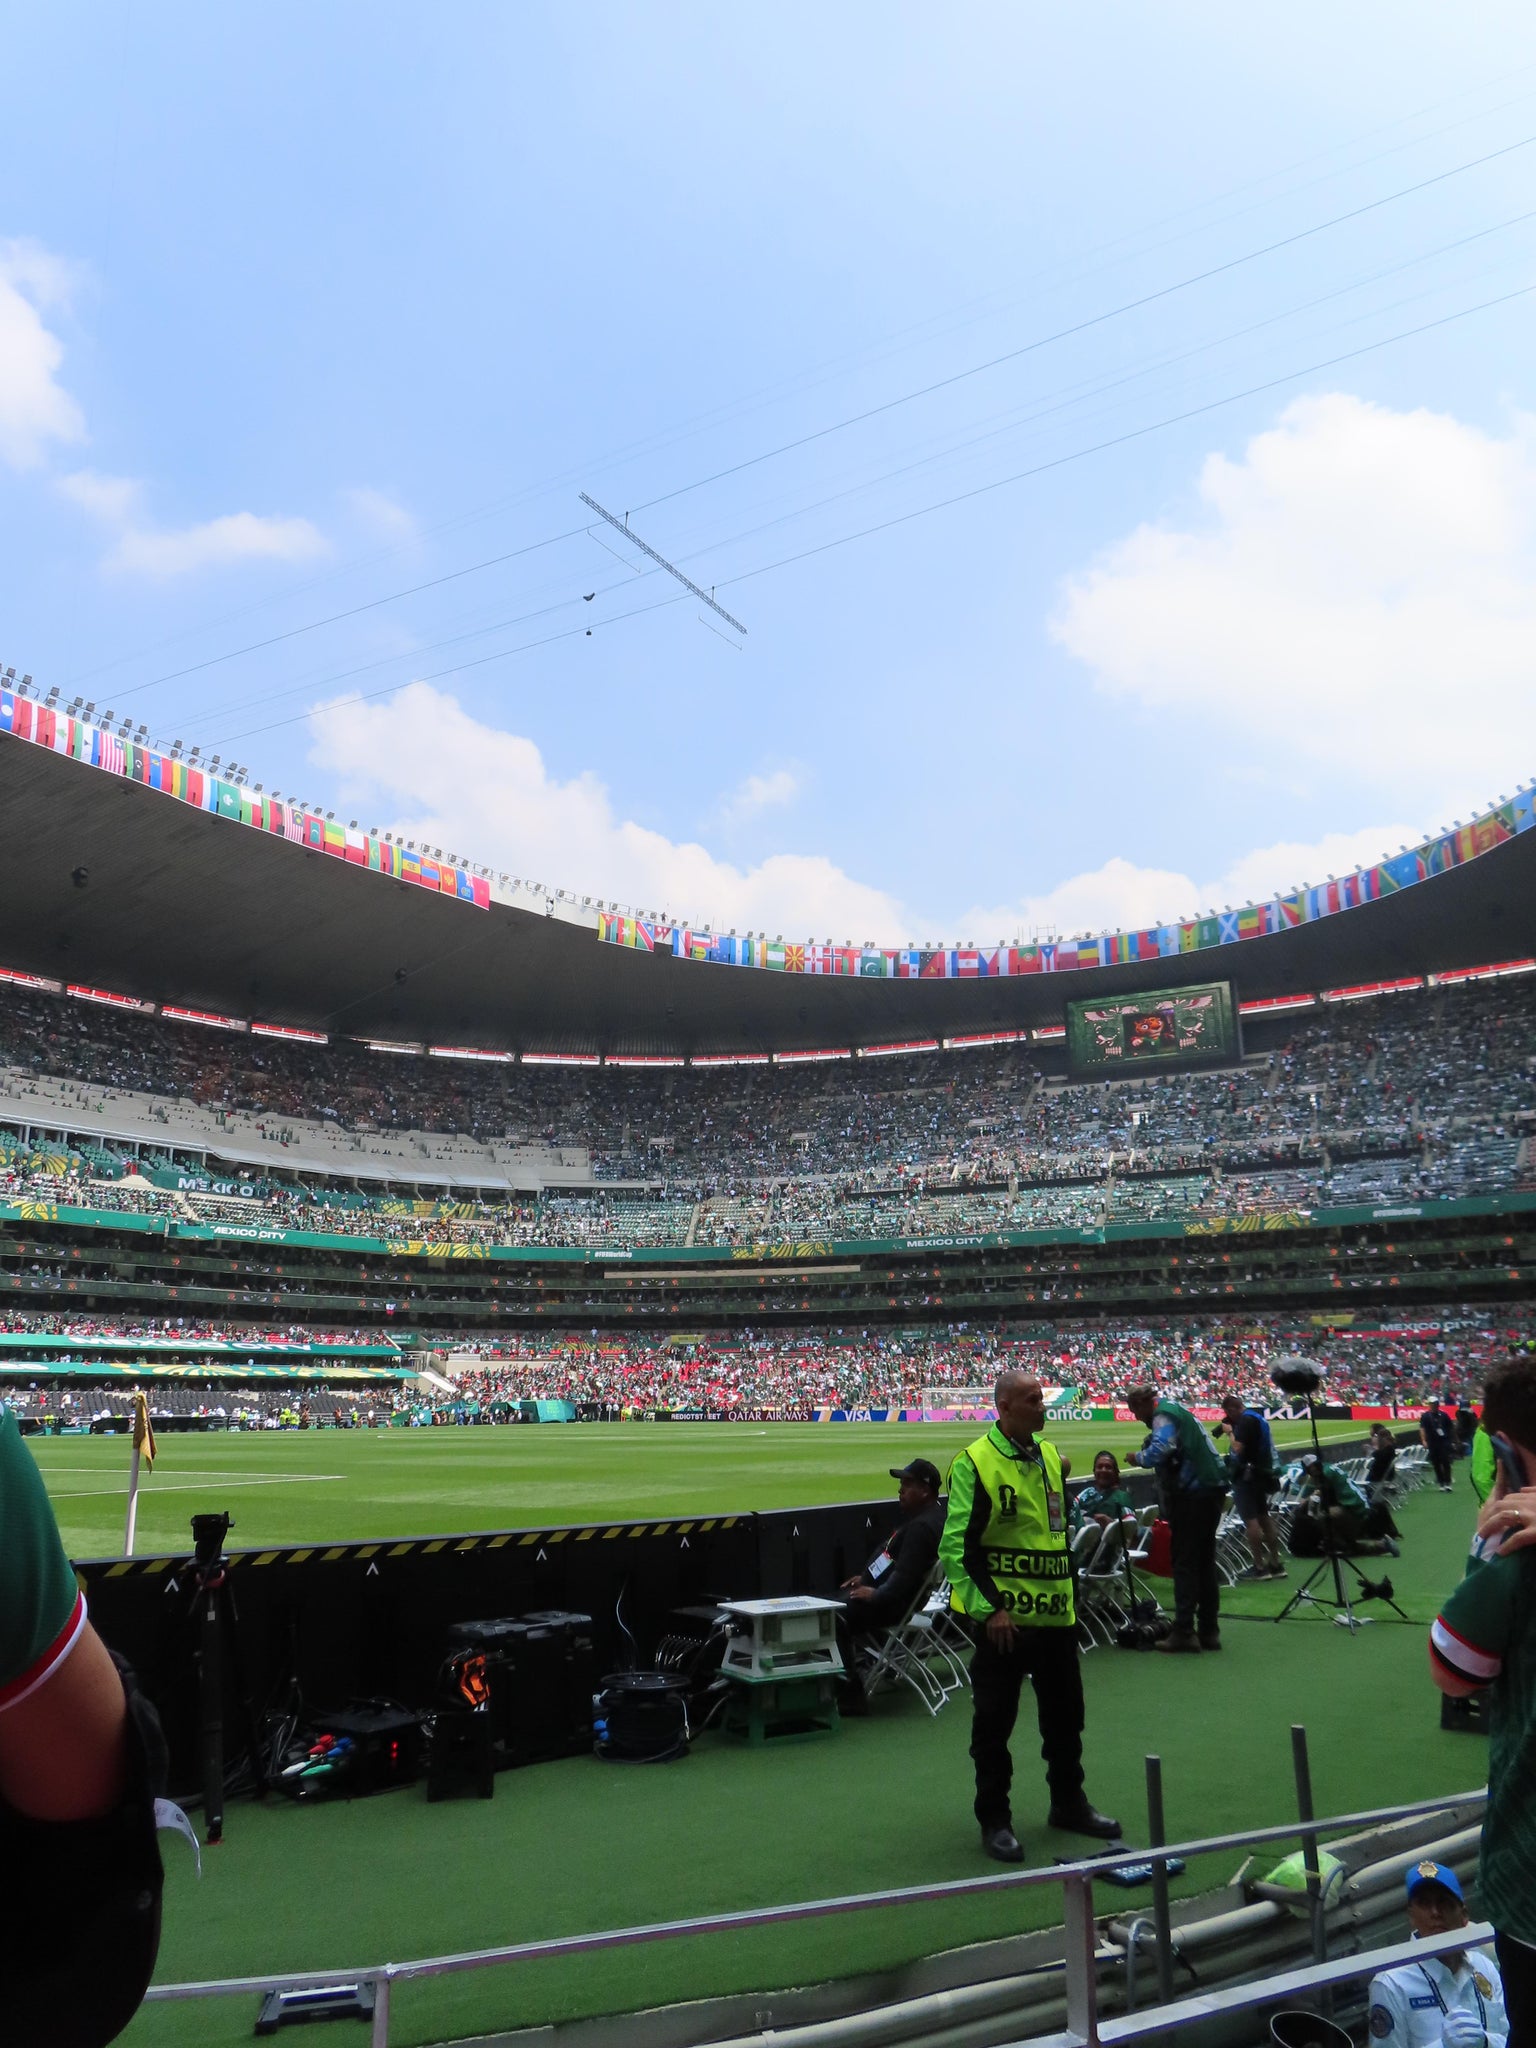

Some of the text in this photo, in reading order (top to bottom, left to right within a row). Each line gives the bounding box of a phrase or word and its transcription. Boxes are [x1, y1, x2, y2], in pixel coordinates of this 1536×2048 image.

[213, 1226, 286, 1240] MEXICO CITY
[907, 1236, 984, 1247] MEXICO CITY
[1380, 1320, 1480, 1332] MEXICO CITY
[232, 1342, 311, 1351] CITY
[796, 1340, 822, 1348] CITY
[728, 1410, 809, 1422] QATAR AIRWAYS
[843, 1410, 872, 1422] VISA
